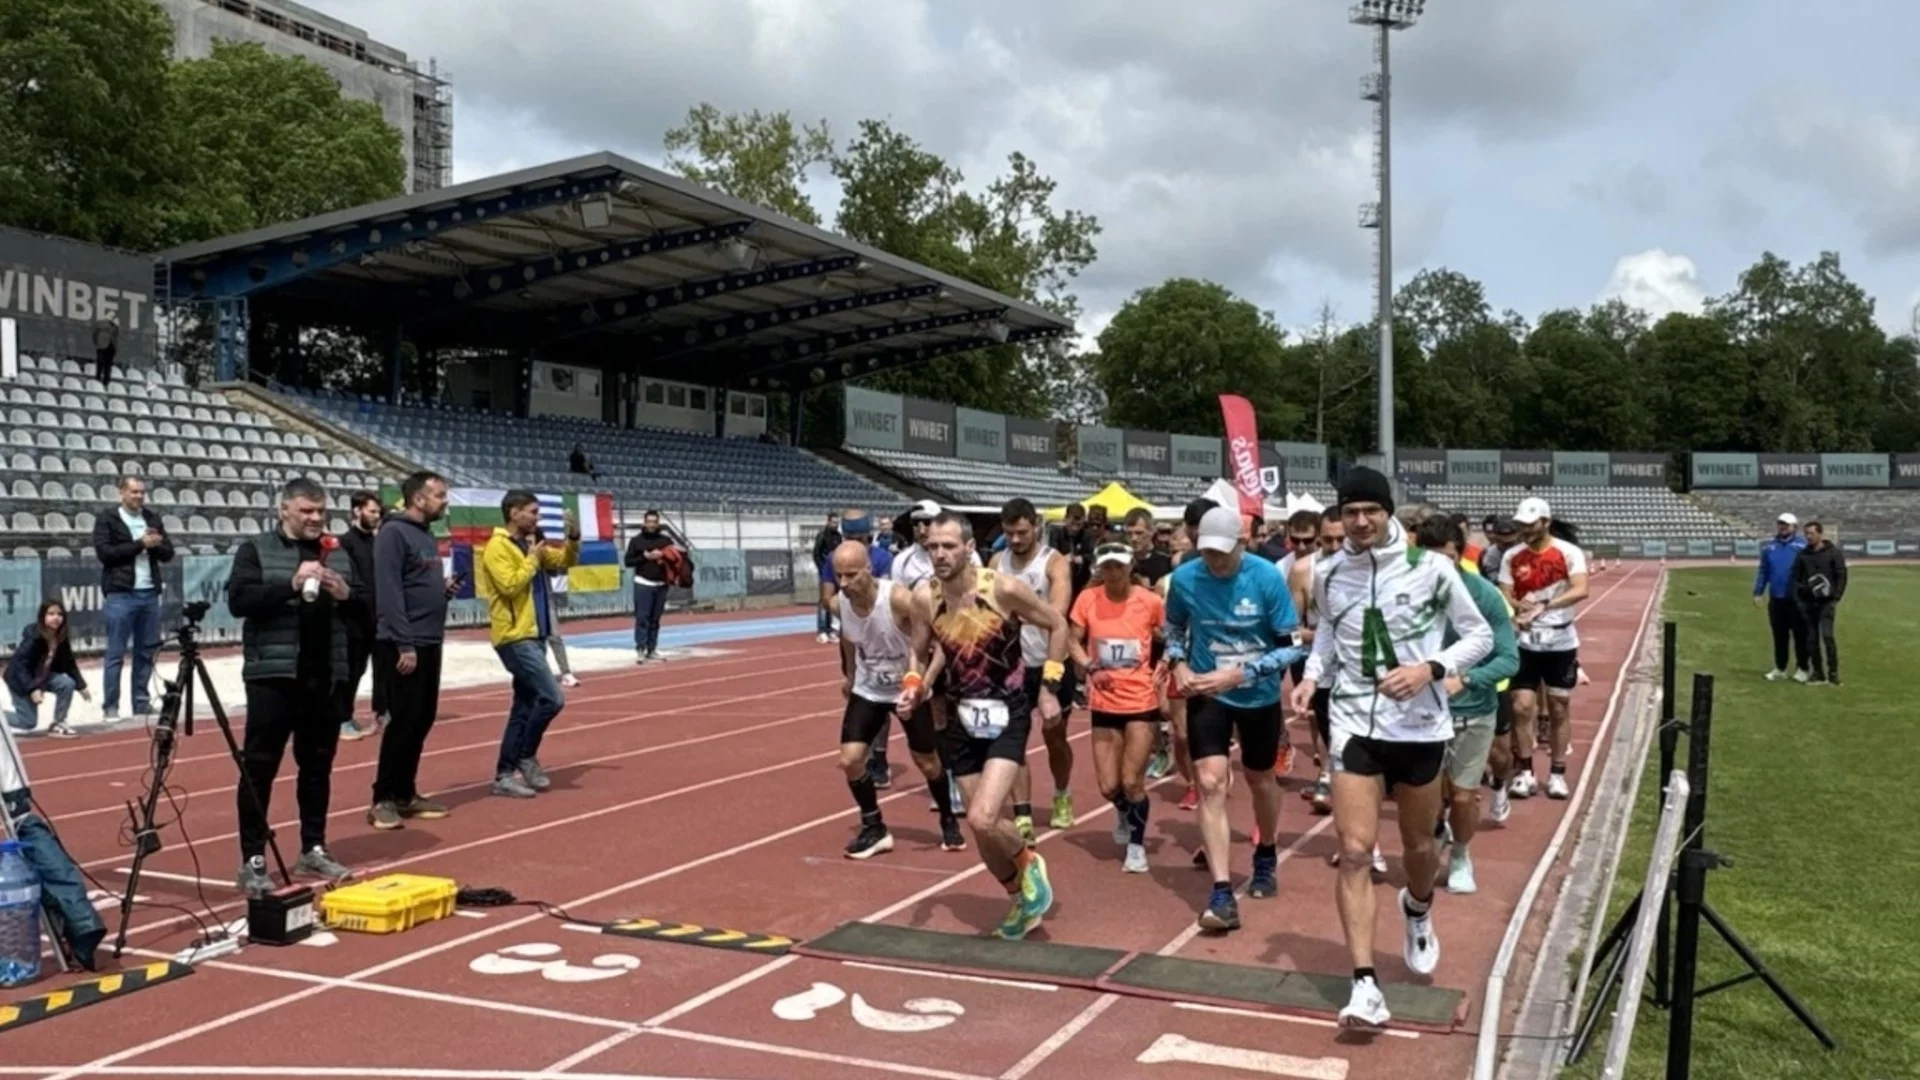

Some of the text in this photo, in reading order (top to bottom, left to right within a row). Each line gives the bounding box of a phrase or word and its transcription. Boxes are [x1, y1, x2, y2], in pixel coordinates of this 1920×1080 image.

[853, 408, 896, 433] WINBET
[908, 418, 948, 443] WINBET
[964, 427, 999, 448] WINBET
[1011, 433, 1049, 453] WINBET
[1127, 444, 1166, 460] WINBET
[1178, 450, 1217, 465] WINBET
[1451, 461, 1497, 474] WINBET
[1503, 462, 1551, 475] WINBET
[1557, 463, 1606, 476] WINBET
[1611, 463, 1663, 477] WINBET
[1698, 463, 1752, 476] WINBET
[1762, 463, 1817, 476] WINBET
[1827, 464, 1882, 477] WINBET
[752, 564, 788, 581] WINBET
[1110, 644, 1124, 661] 17
[972, 706, 990, 727] 73
[772, 981, 966, 1031] 2
